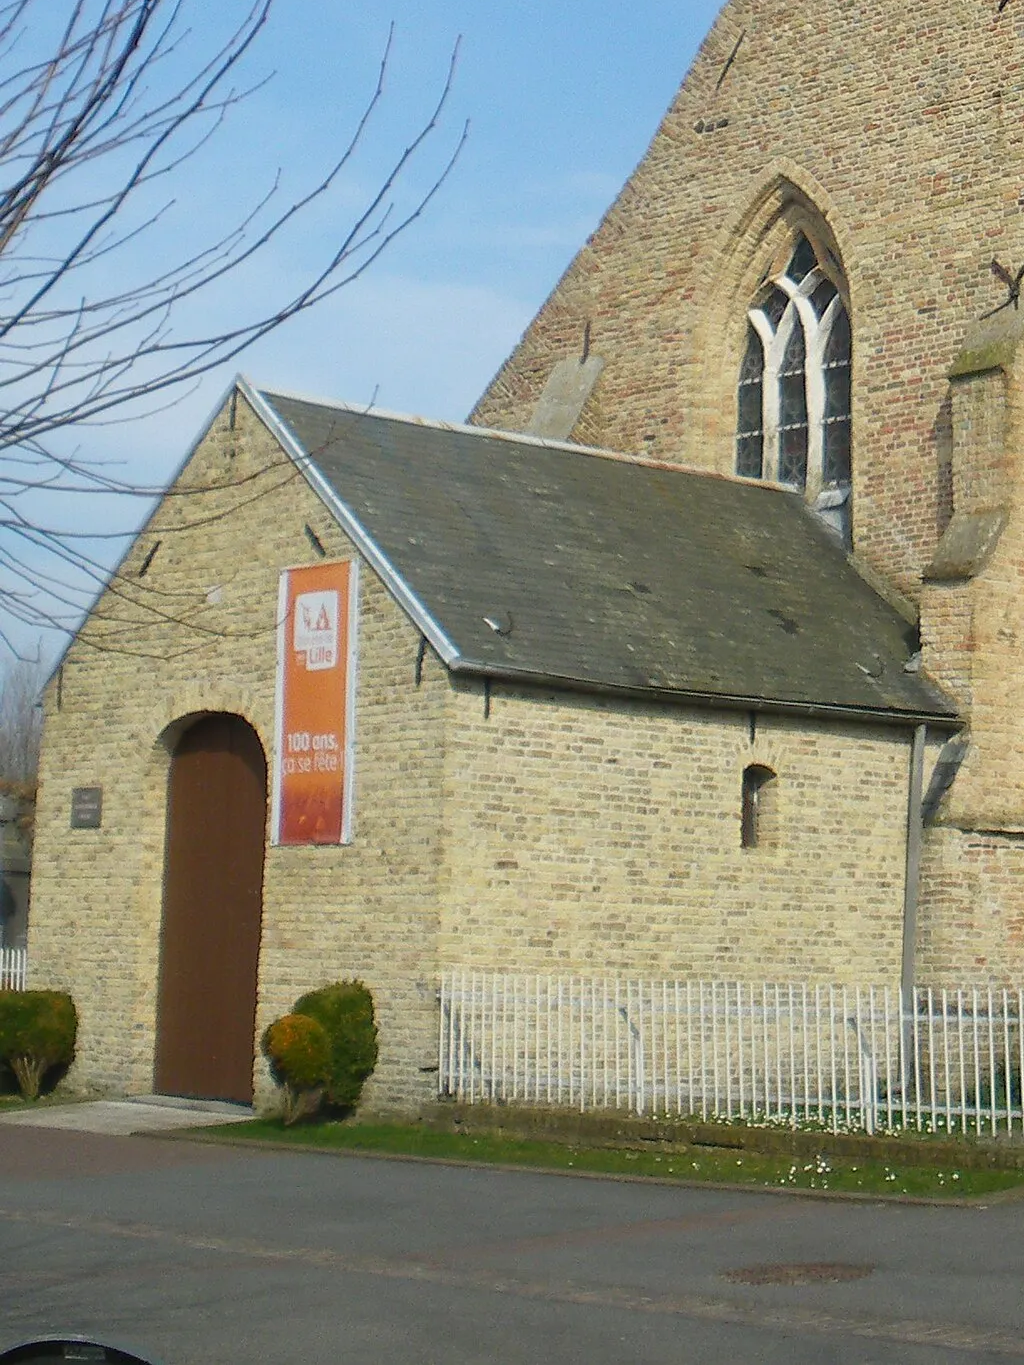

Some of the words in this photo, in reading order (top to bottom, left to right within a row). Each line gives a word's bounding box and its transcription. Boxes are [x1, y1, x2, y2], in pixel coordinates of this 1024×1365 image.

[309, 646, 333, 665] Lille
[287, 733, 310, 752] 100
[296, 757, 311, 773] se
